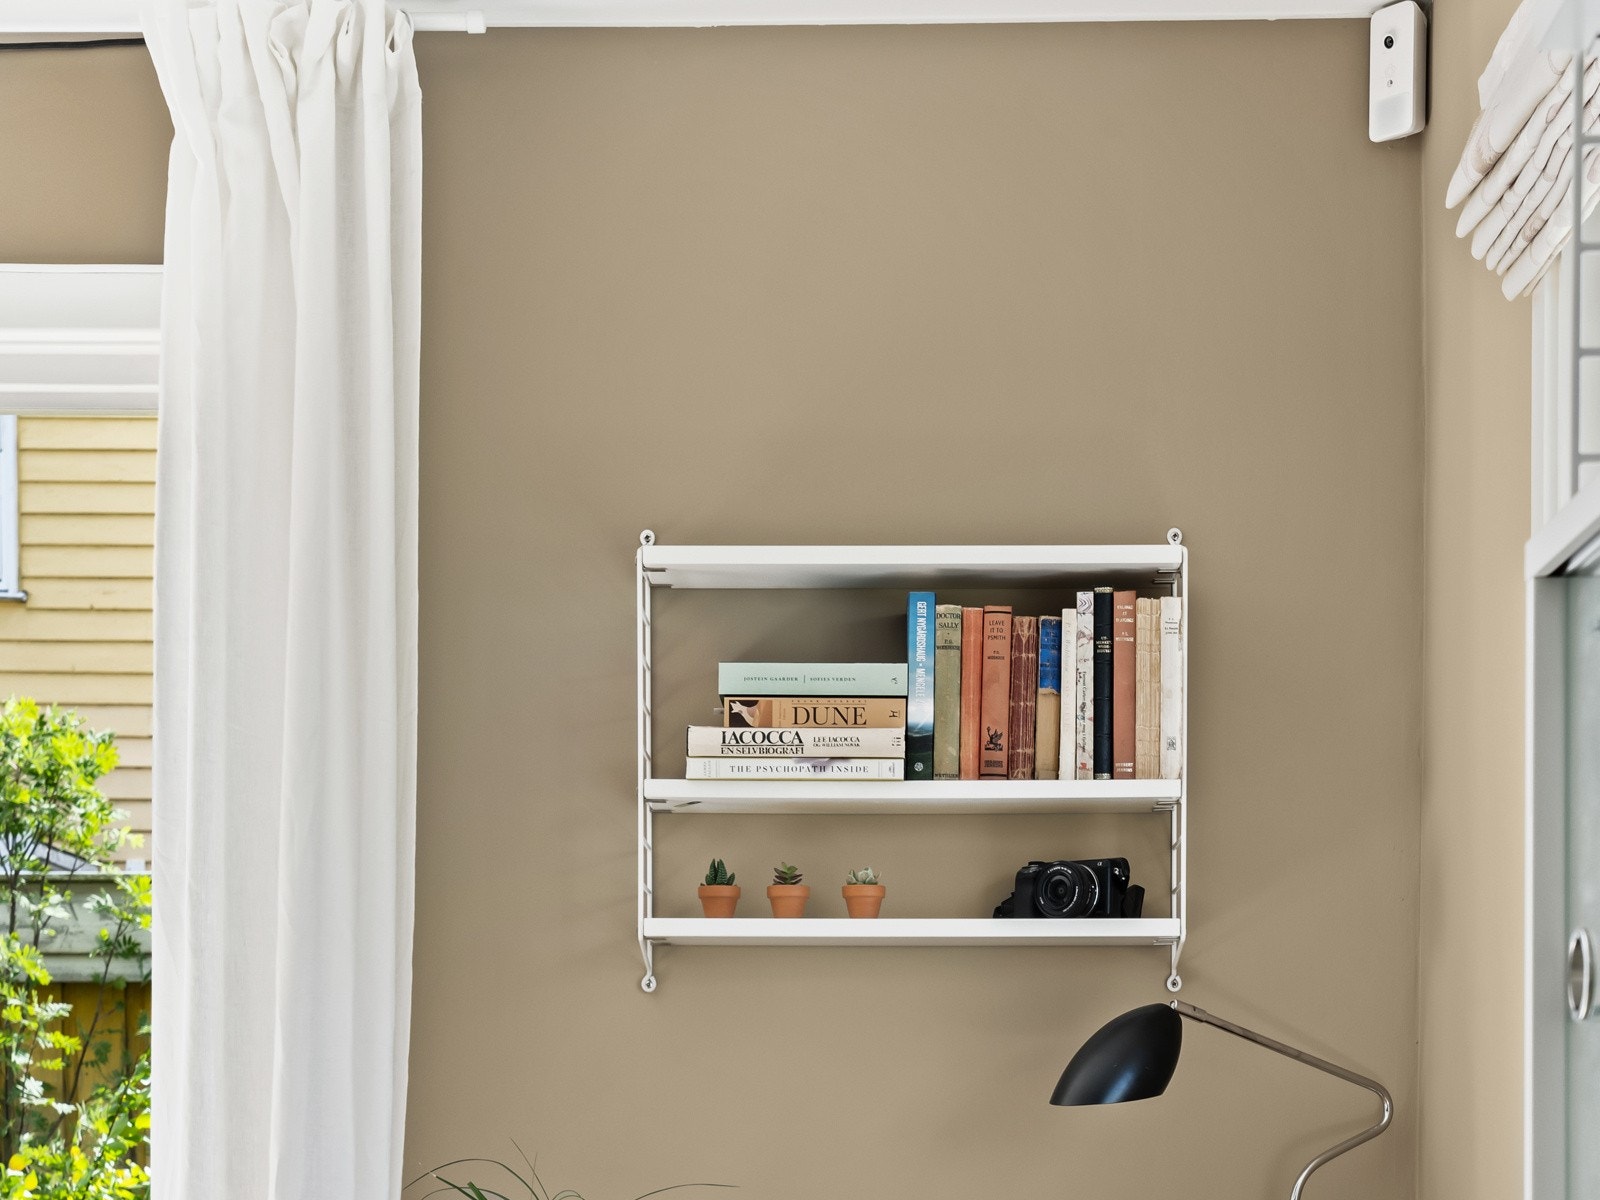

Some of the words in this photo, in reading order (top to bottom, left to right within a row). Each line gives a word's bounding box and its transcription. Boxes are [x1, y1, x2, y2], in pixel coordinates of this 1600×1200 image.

[916, 601, 927, 616] GERT
[915, 617, 927, 662] NYGÅRDSHAUG
[915, 667, 926, 698] MENGELE
[792, 706, 867, 726] DUNE
[721, 730, 804, 745] IACOCCA
[720, 746, 734, 755] EN
[735, 746, 804, 755] SELVBIOGRAFI
[729, 765, 751, 773] THE
[756, 765, 826, 773] PSYCHOPATH
[830, 765, 869, 773] INSIDE
